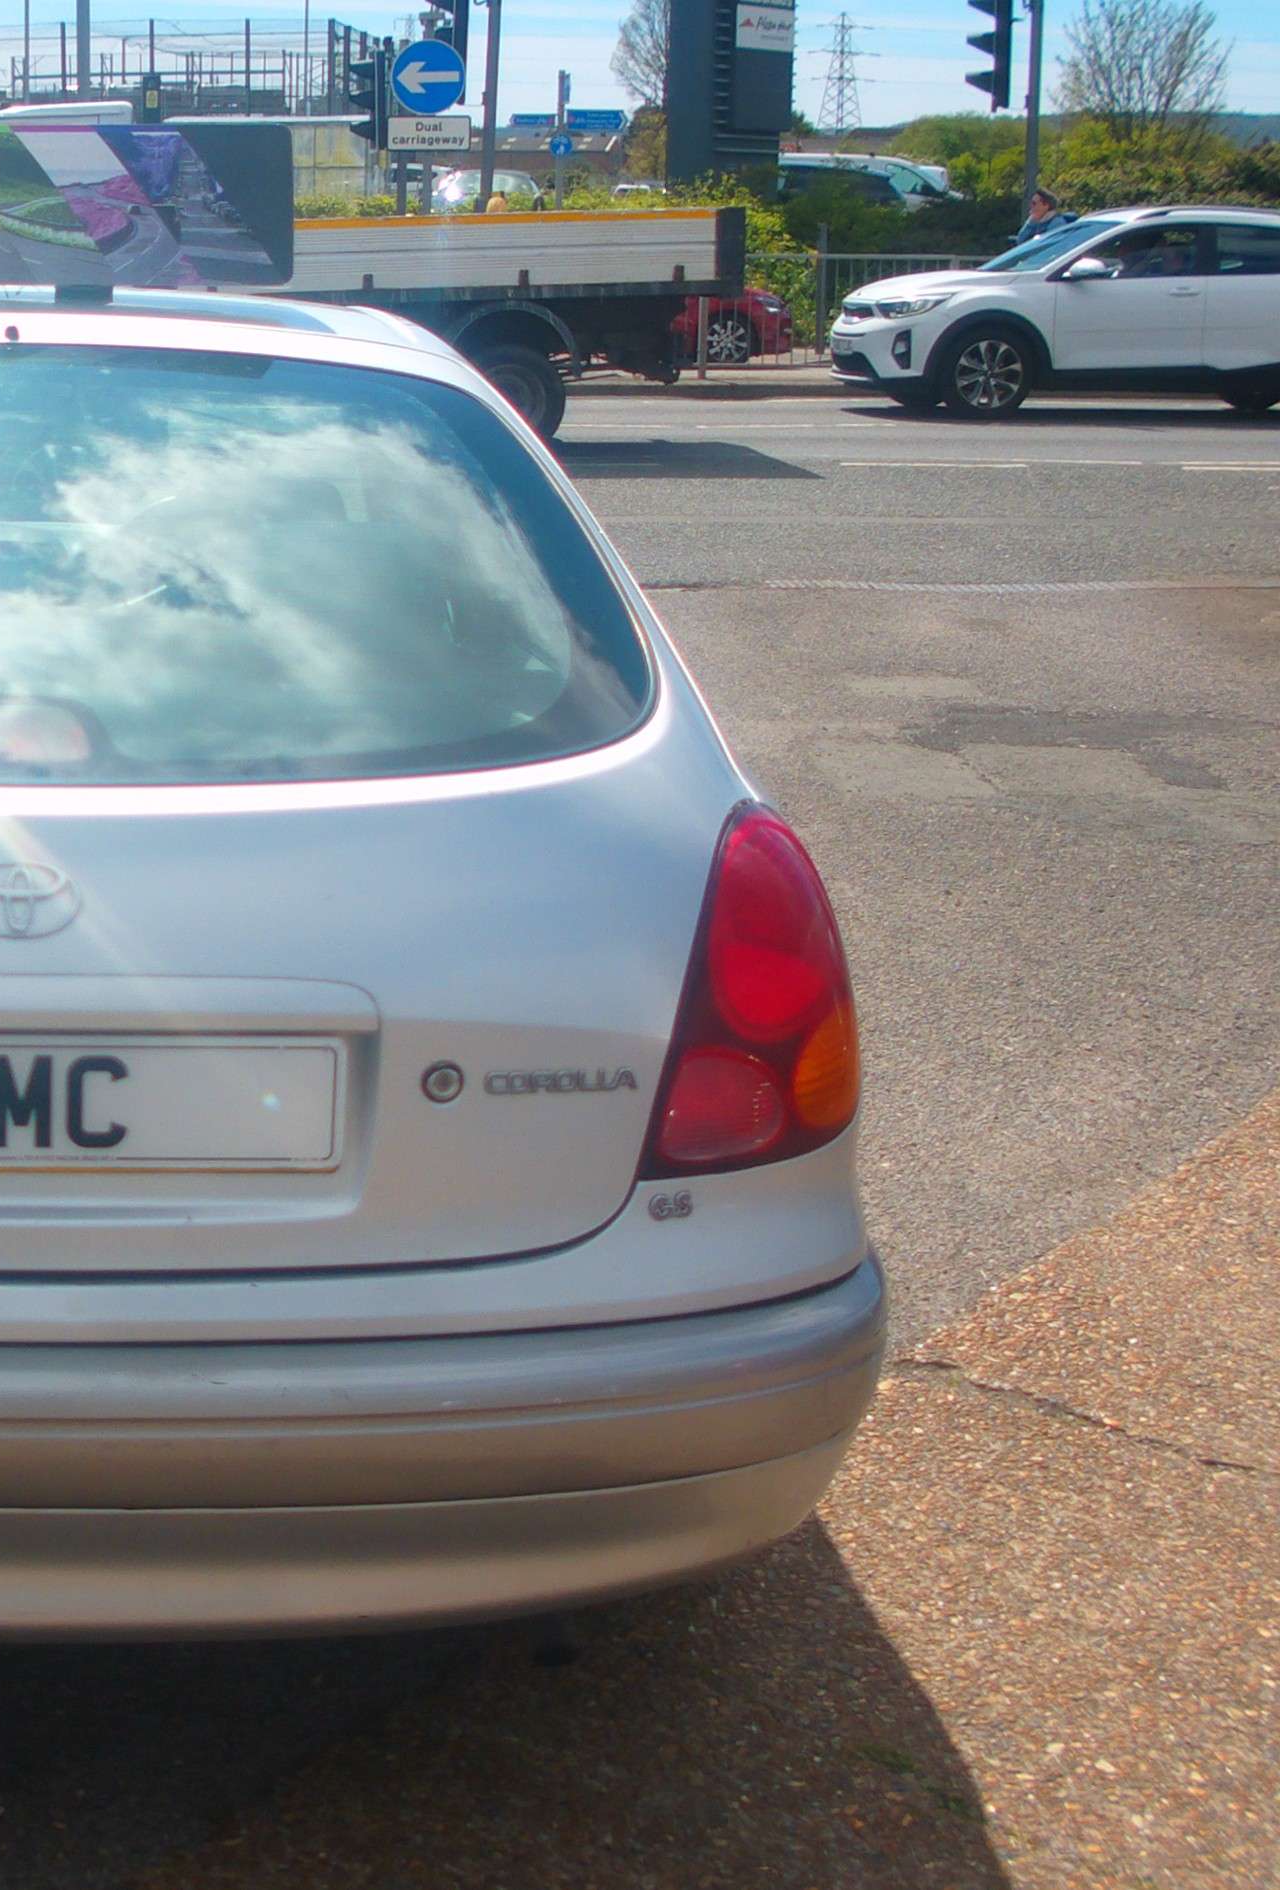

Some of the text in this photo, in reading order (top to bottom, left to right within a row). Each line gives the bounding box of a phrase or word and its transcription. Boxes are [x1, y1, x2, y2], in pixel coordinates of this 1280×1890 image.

[415, 122, 442, 132] Dual
[392, 135, 464, 146] carriageway
[483, 1066, 637, 1095] COROLLA
[648, 1190, 693, 1221] GS
